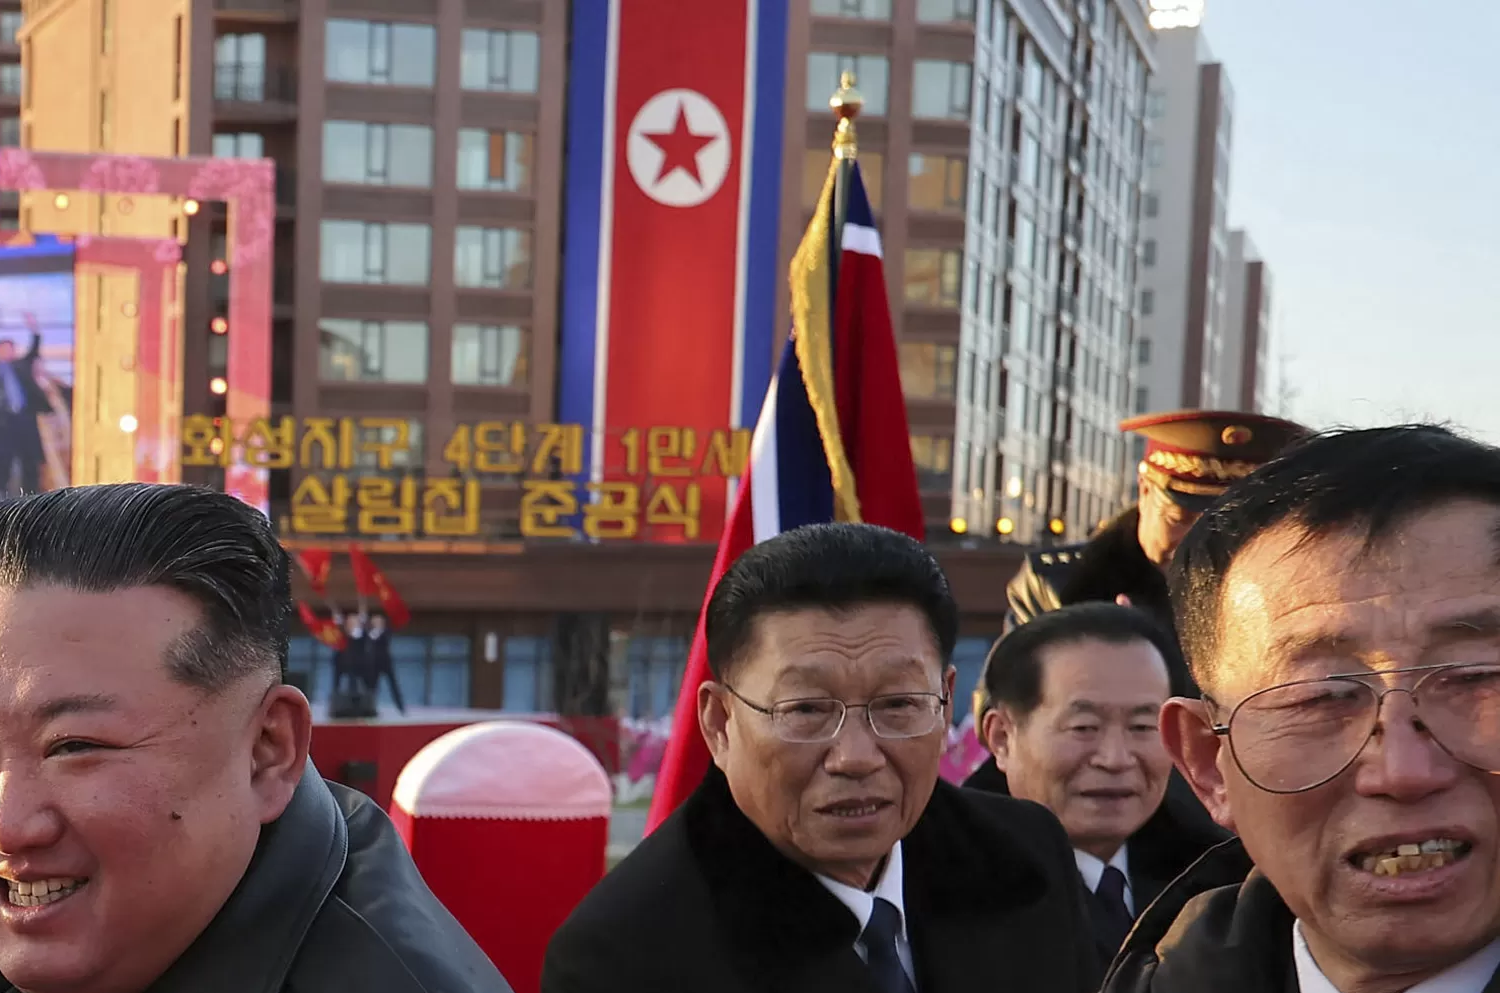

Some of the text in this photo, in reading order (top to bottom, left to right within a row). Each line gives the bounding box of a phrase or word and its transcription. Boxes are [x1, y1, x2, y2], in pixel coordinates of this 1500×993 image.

[181, 413, 410, 470] 화성지구
[444, 420, 583, 474] 4단계
[292, 474, 699, 539] 살림집 준공식
